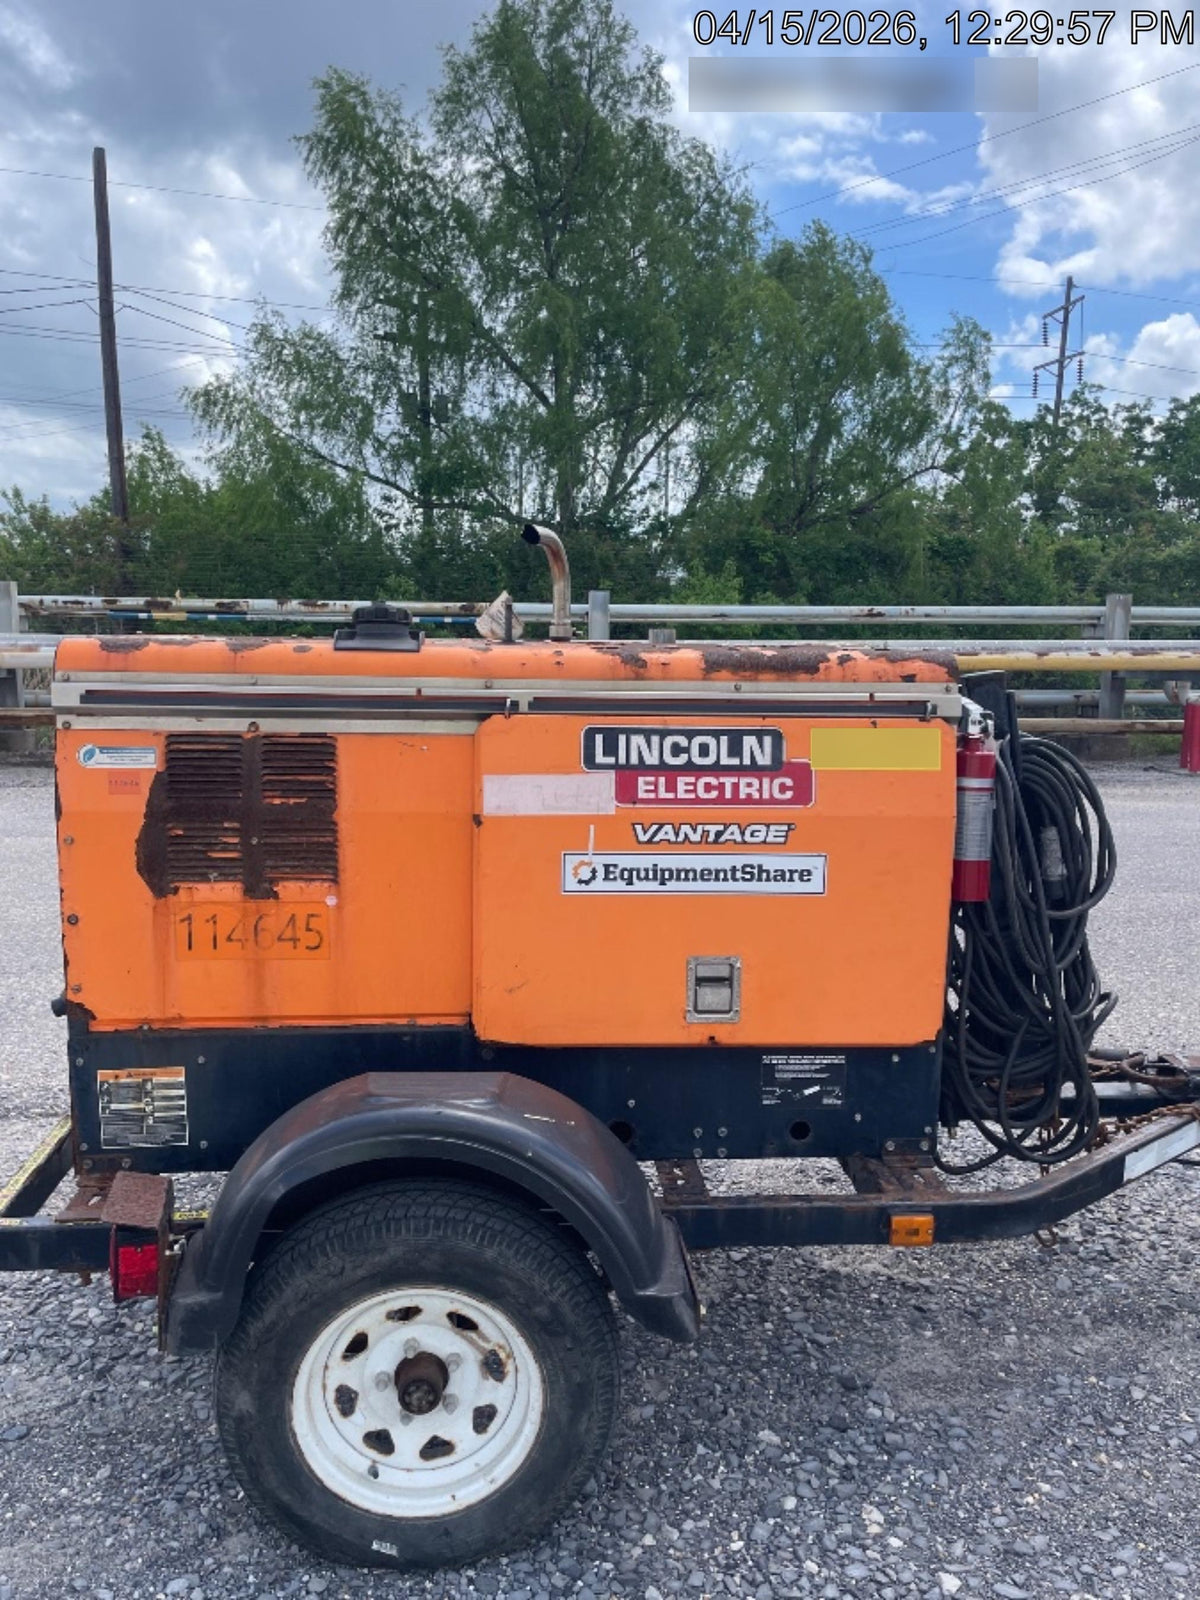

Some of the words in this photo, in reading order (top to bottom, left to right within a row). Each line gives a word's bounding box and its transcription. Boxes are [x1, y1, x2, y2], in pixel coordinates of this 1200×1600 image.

[594, 733, 773, 766] LINCOLN
[637, 775, 794, 800] ELECTRIC
[632, 822, 791, 845] VANTAGE
[601, 862, 813, 887] EquipmentShare
[178, 912, 324, 951] 114645
